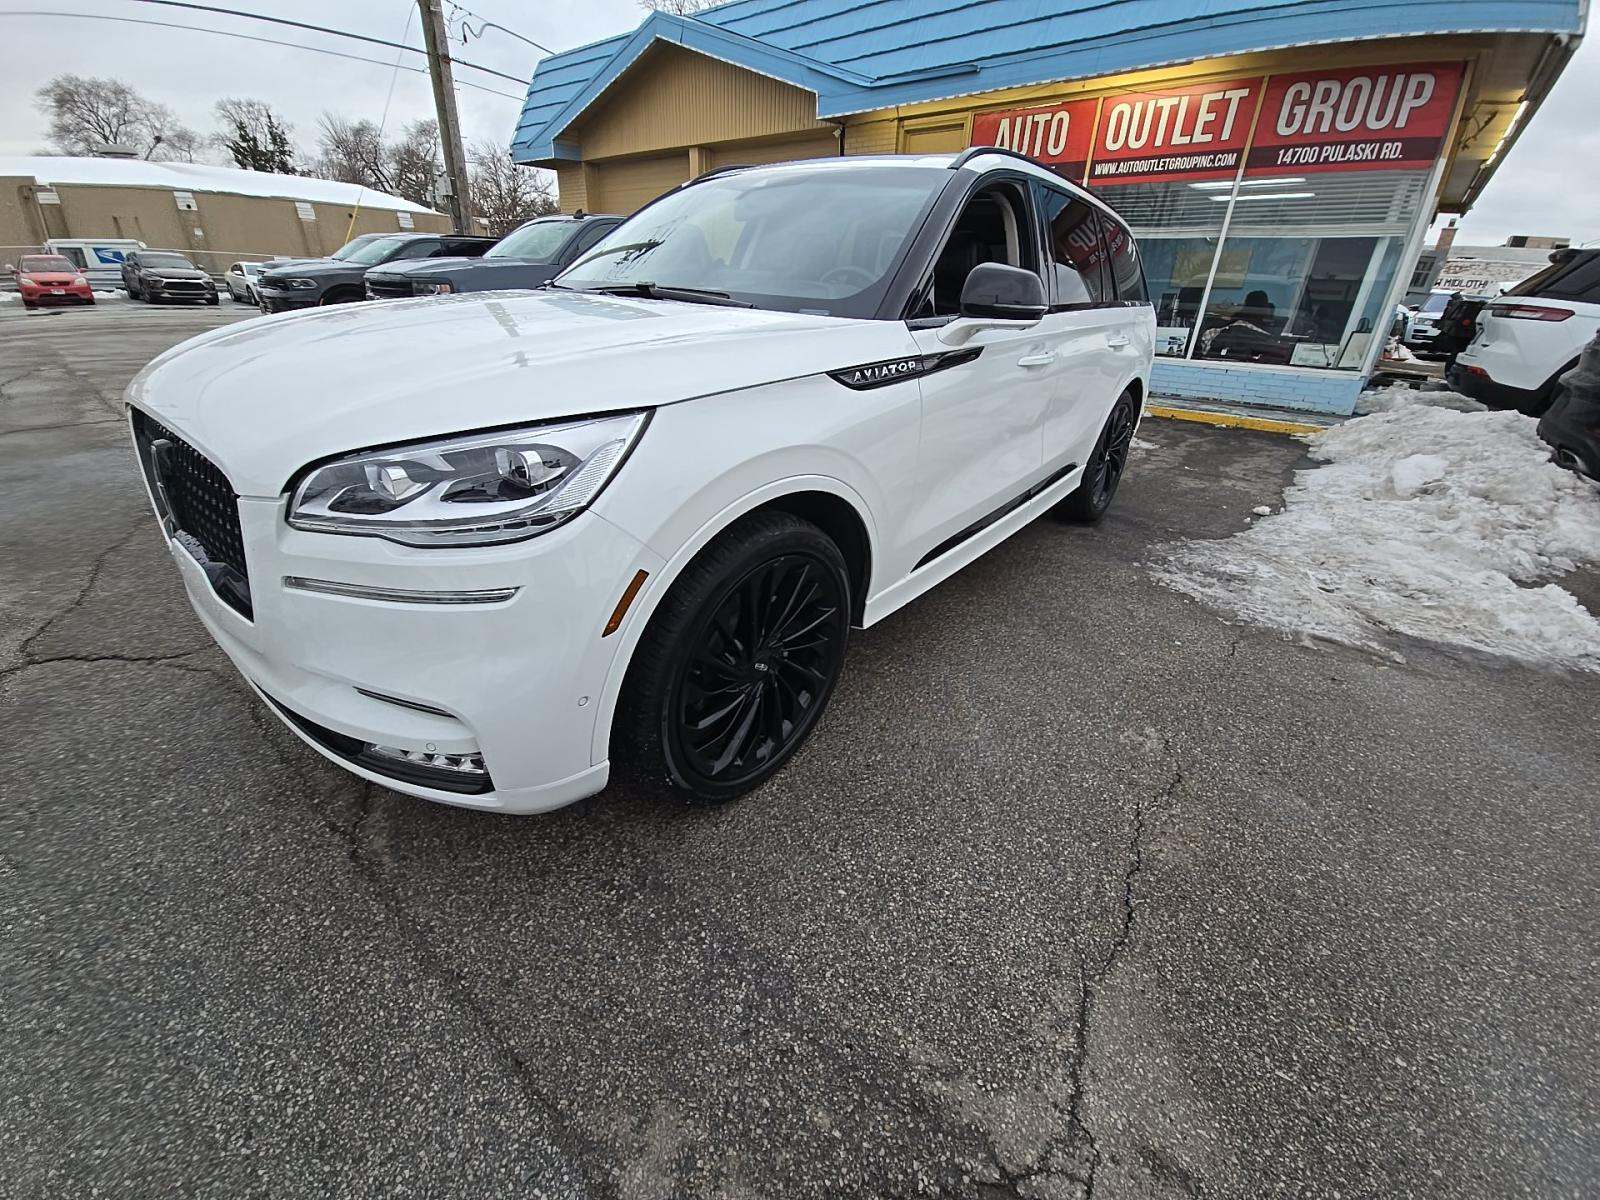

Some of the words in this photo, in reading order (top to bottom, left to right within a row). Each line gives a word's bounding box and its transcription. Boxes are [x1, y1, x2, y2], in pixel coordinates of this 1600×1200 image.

[994, 110, 1070, 157] AUTO
[1105, 88, 1250, 151] OUTLET
[1276, 73, 1436, 136] GROUP
[1094, 152, 1237, 176] WWW.AUTOOUTLETGROUPINC.COM
[1277, 146, 1320, 165] 14700
[1319, 142, 1380, 163] PULASKI
[1379, 141, 1403, 160] RD.
[853, 360, 916, 383] AVIATOR
